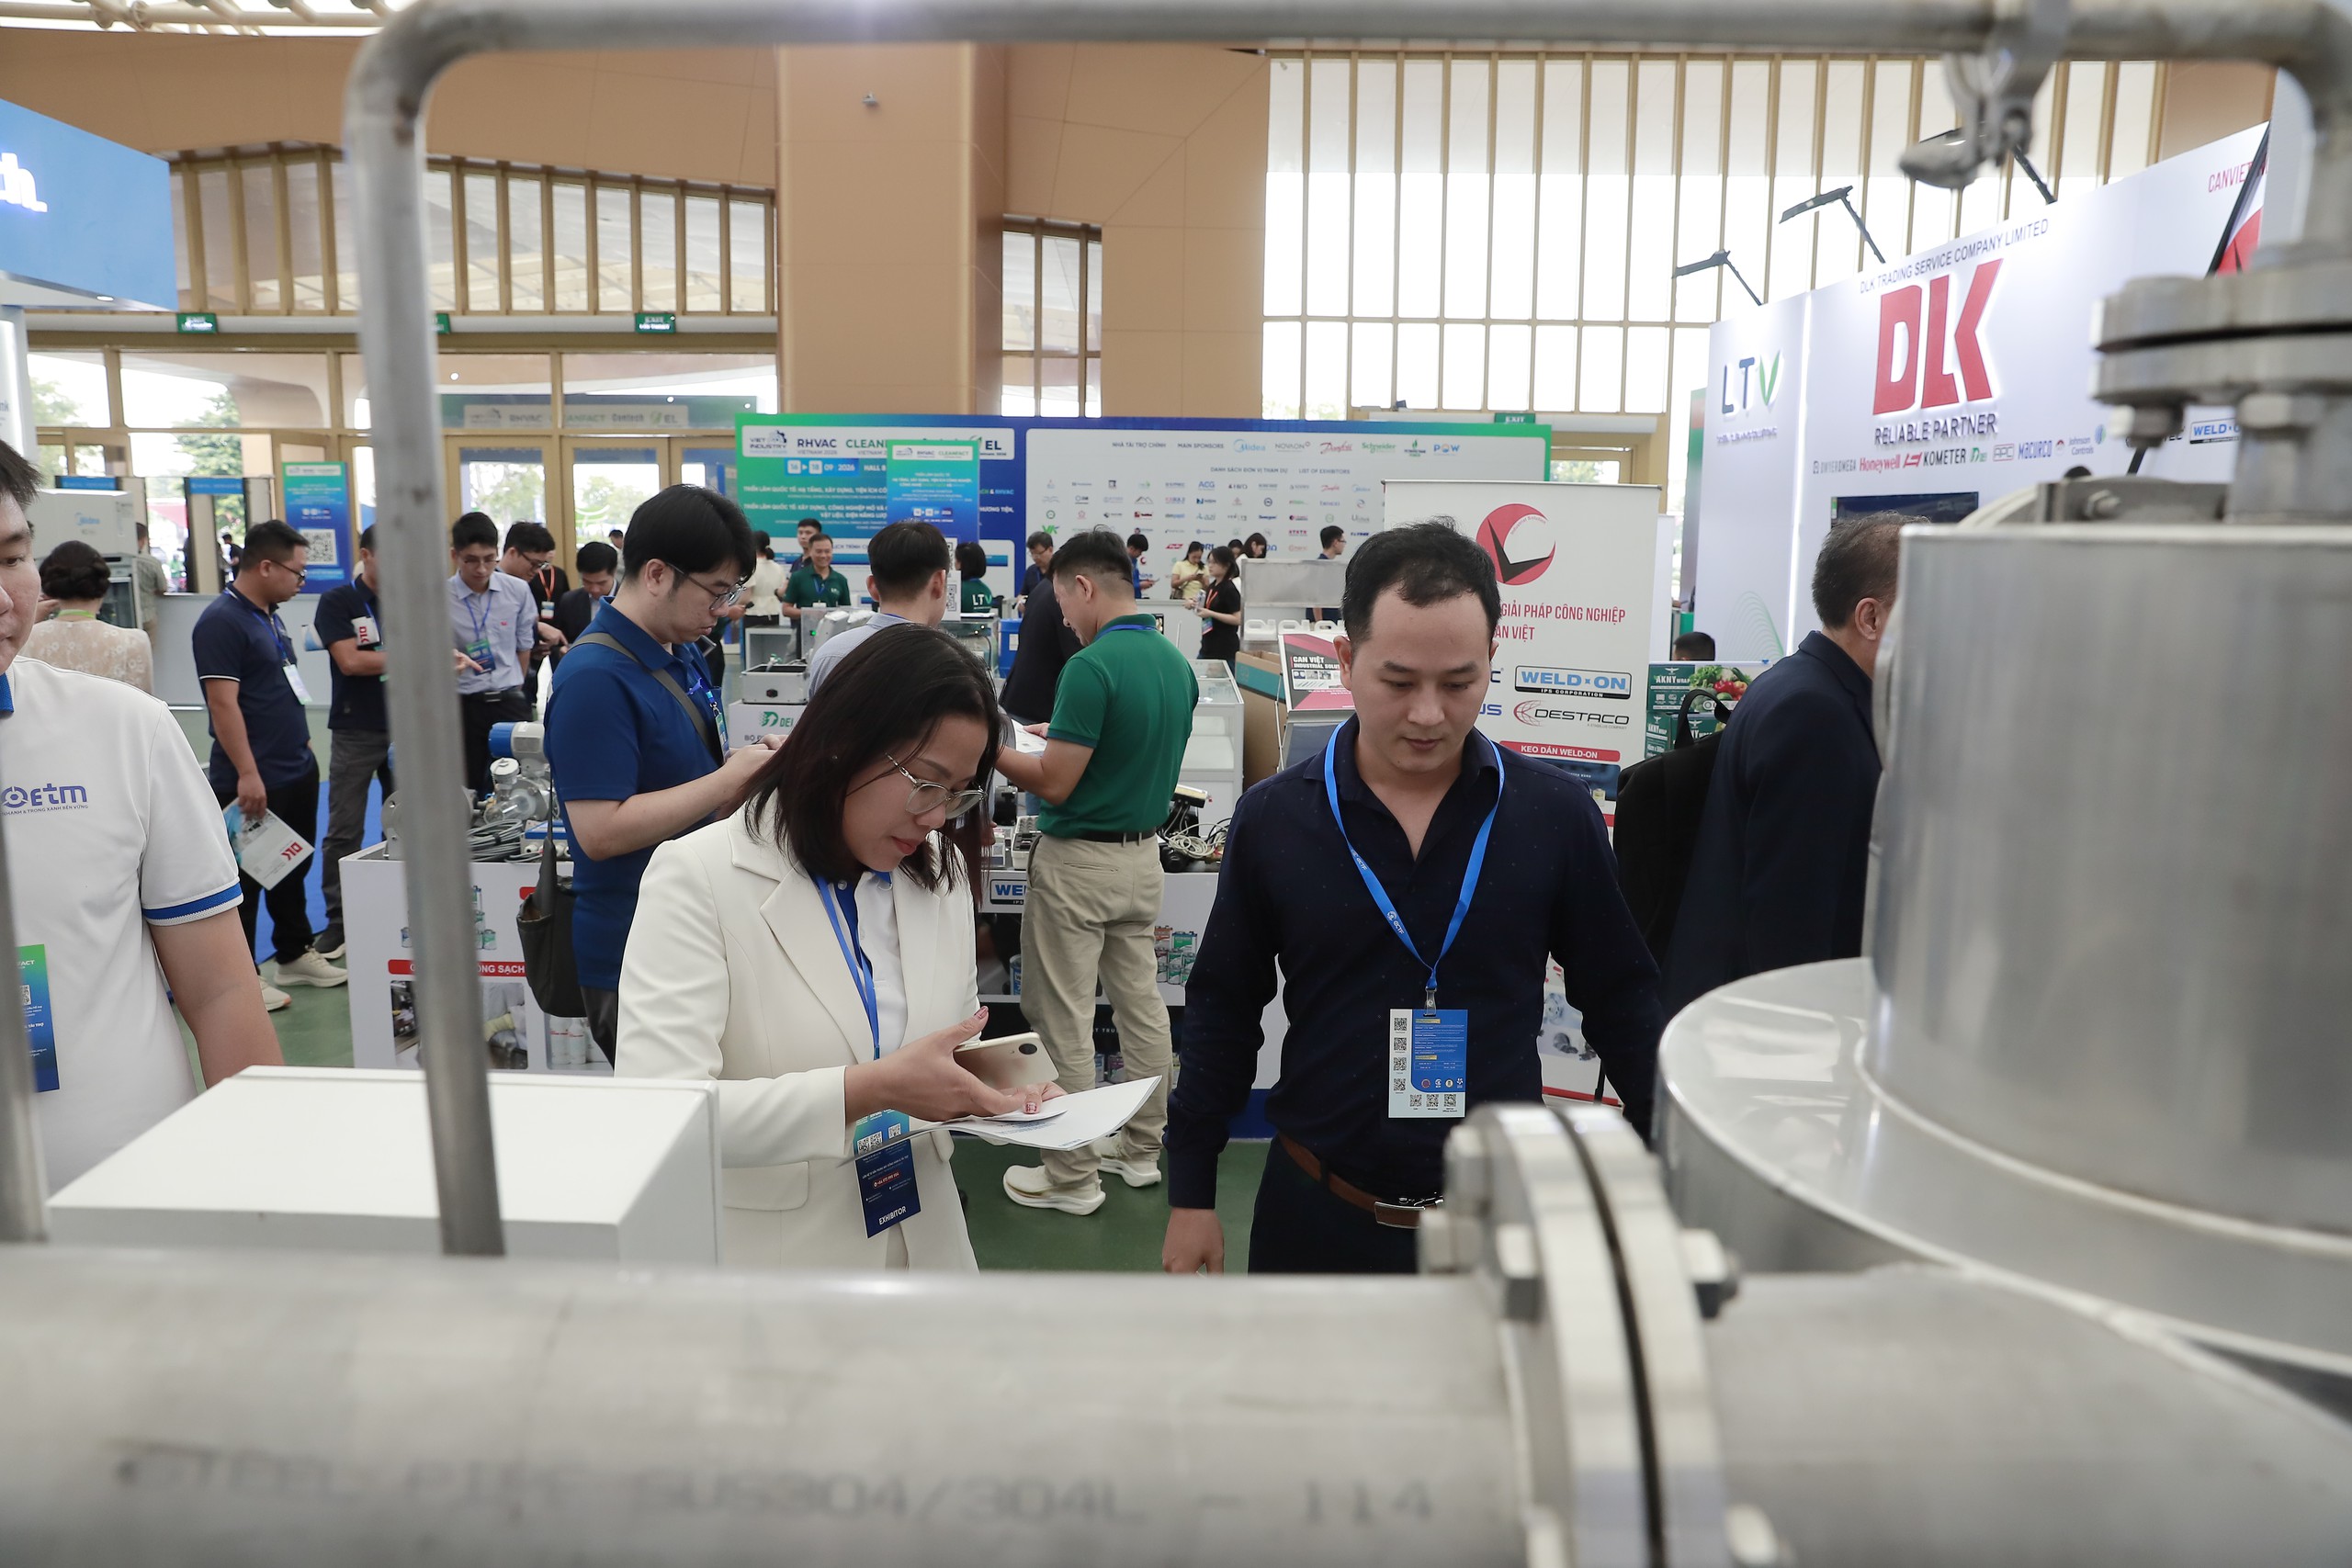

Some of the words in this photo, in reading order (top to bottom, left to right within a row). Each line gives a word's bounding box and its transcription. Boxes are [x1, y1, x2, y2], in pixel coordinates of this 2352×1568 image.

[1860, 279, 1876, 294] DLK
[1877, 269, 1912, 288] TRADING
[1914, 251, 1952, 276] SERVICE
[1954, 233, 2004, 263] COMPANY
[2005, 219, 2049, 246] LIMITED
[1872, 258, 2004, 415] DLK
[1722, 349, 1781, 414] LTV
[1874, 422, 1928, 445] RELIABLE
[1933, 413, 1996, 438] PARTNER
[797, 439, 837, 448] RHVAC
[985, 441, 1001, 450] EL
[1362, 442, 1396, 454] Schneider
[1860, 455, 1900, 473] Honeywell
[1924, 448, 1967, 466] KOMETER
[972, 594, 992, 605] LTV
[1523, 603, 1553, 618] PHÁP
[1555, 604, 1583, 621] CÔNG
[1586, 606, 1626, 626] NGHIỆP
[1512, 624, 1535, 642] VIỆT
[1309, 655, 1325, 663] VIỆT
[1656, 675, 1676, 683] AKNY
[1555, 690, 1604, 698] CORPORATION
[1534, 709, 1630, 725] DESTACO
[1521, 745, 1538, 753] KEO
[1540, 745, 1558, 754] DÁN
[1559, 748, 1598, 759] WELD-ON
[281, 841, 303, 862] DLK
[995, 885, 1026, 896] WE
[498, 964, 525, 975] SẠCH
[878, 1205, 907, 1225] EXHIBITOR
